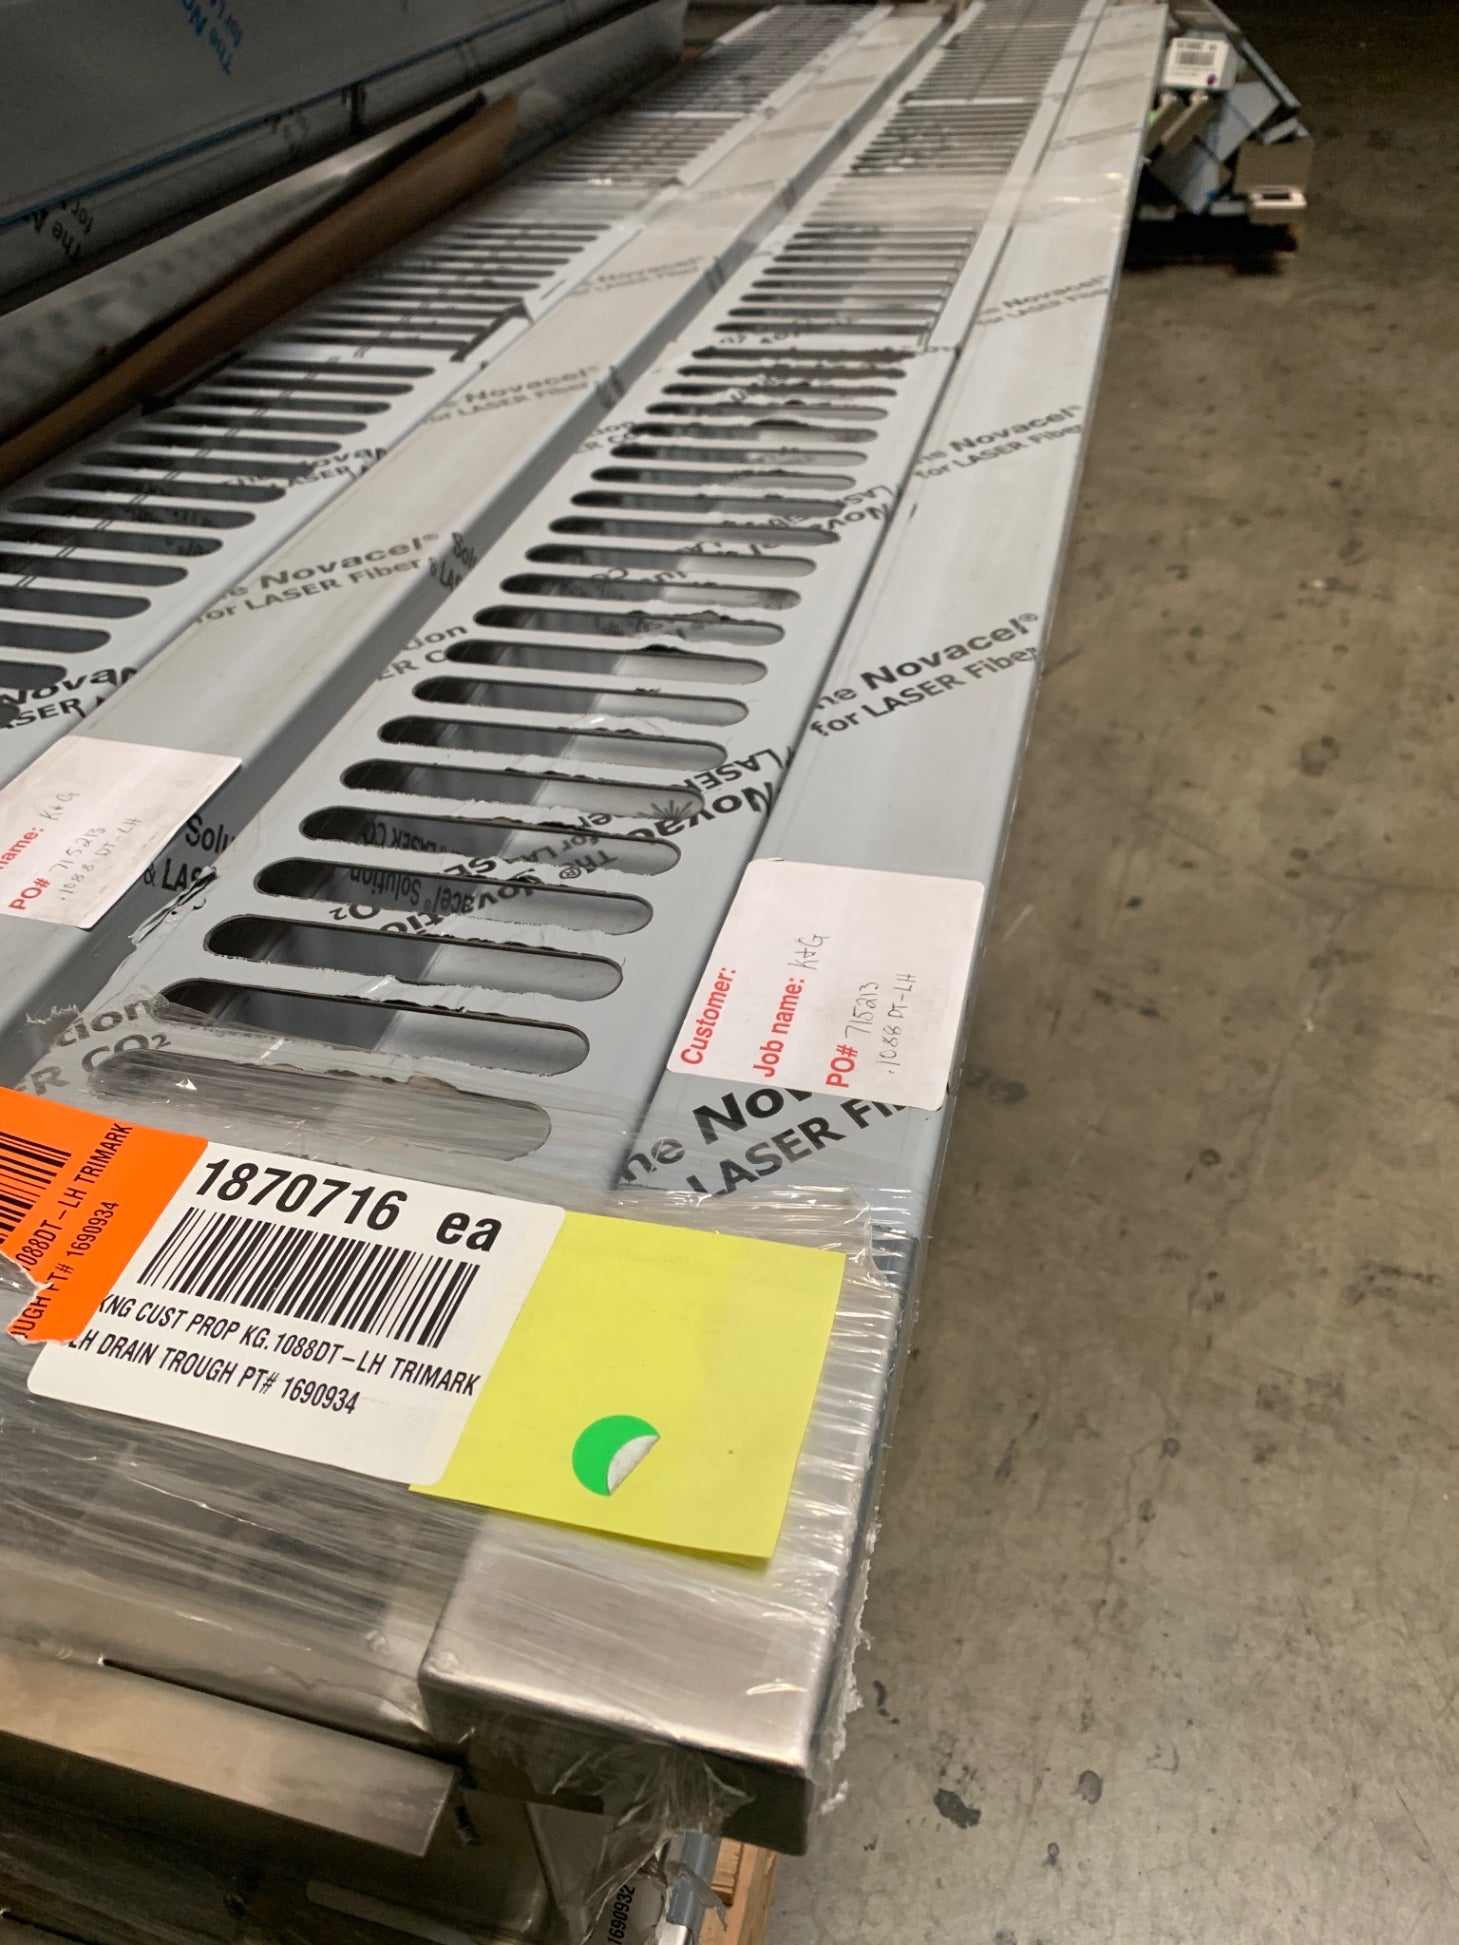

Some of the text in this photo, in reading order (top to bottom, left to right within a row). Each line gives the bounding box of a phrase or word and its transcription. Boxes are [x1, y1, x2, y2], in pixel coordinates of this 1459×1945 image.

[953, 441, 1030, 468] LASER
[244, 577, 342, 611] LASER
[348, 557, 421, 585] Fiber
[809, 646, 1038, 737] for LASER Fiber
[8, 876, 51, 911] PO#
[680, 966, 737, 1066] Customer:
[752, 976, 806, 1078] Job name:
[843, 980, 880, 1039] 715213
[825, 1043, 859, 1088] PO#
[73, 1122, 134, 1184] TRIMARK
[685, 1117, 847, 1196] LASER
[66, 1200, 120, 1258] 1690934
[195, 1158, 503, 1252] 1870716 ea
[96, 1333, 160, 1366] DRAIN
[158, 1346, 239, 1385] TROUGH
[236, 1365, 281, 1395] PT#
[280, 1376, 361, 1415] 1690934
[135, 1301, 189, 1328] CUST
[184, 1312, 242, 1341] PROP
[389, 1356, 482, 1397] TRIMARK
[607, 1884, 636, 1945] 1690932
